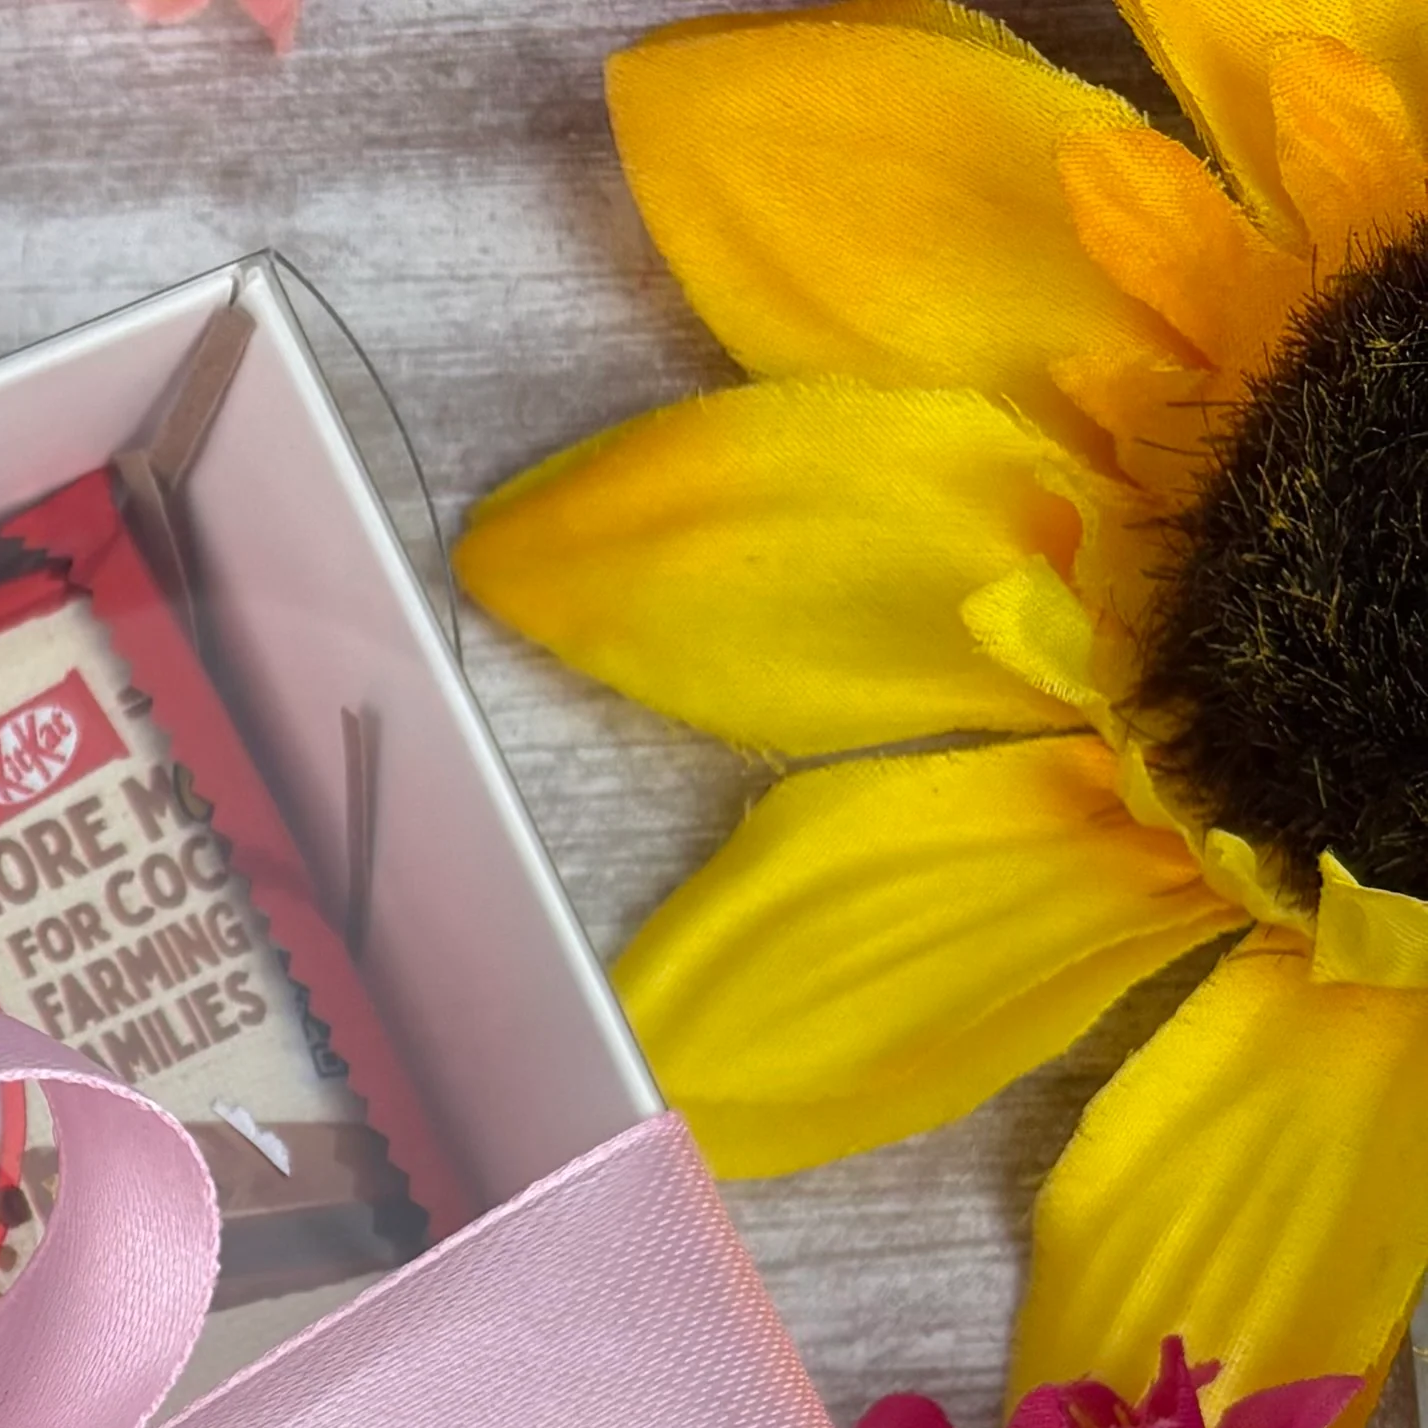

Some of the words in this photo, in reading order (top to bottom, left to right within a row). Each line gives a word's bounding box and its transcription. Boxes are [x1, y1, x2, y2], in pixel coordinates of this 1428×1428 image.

[5, 902, 112, 980] FOR
[106, 834, 229, 928] COC
[29, 901, 252, 1042] FARMING
